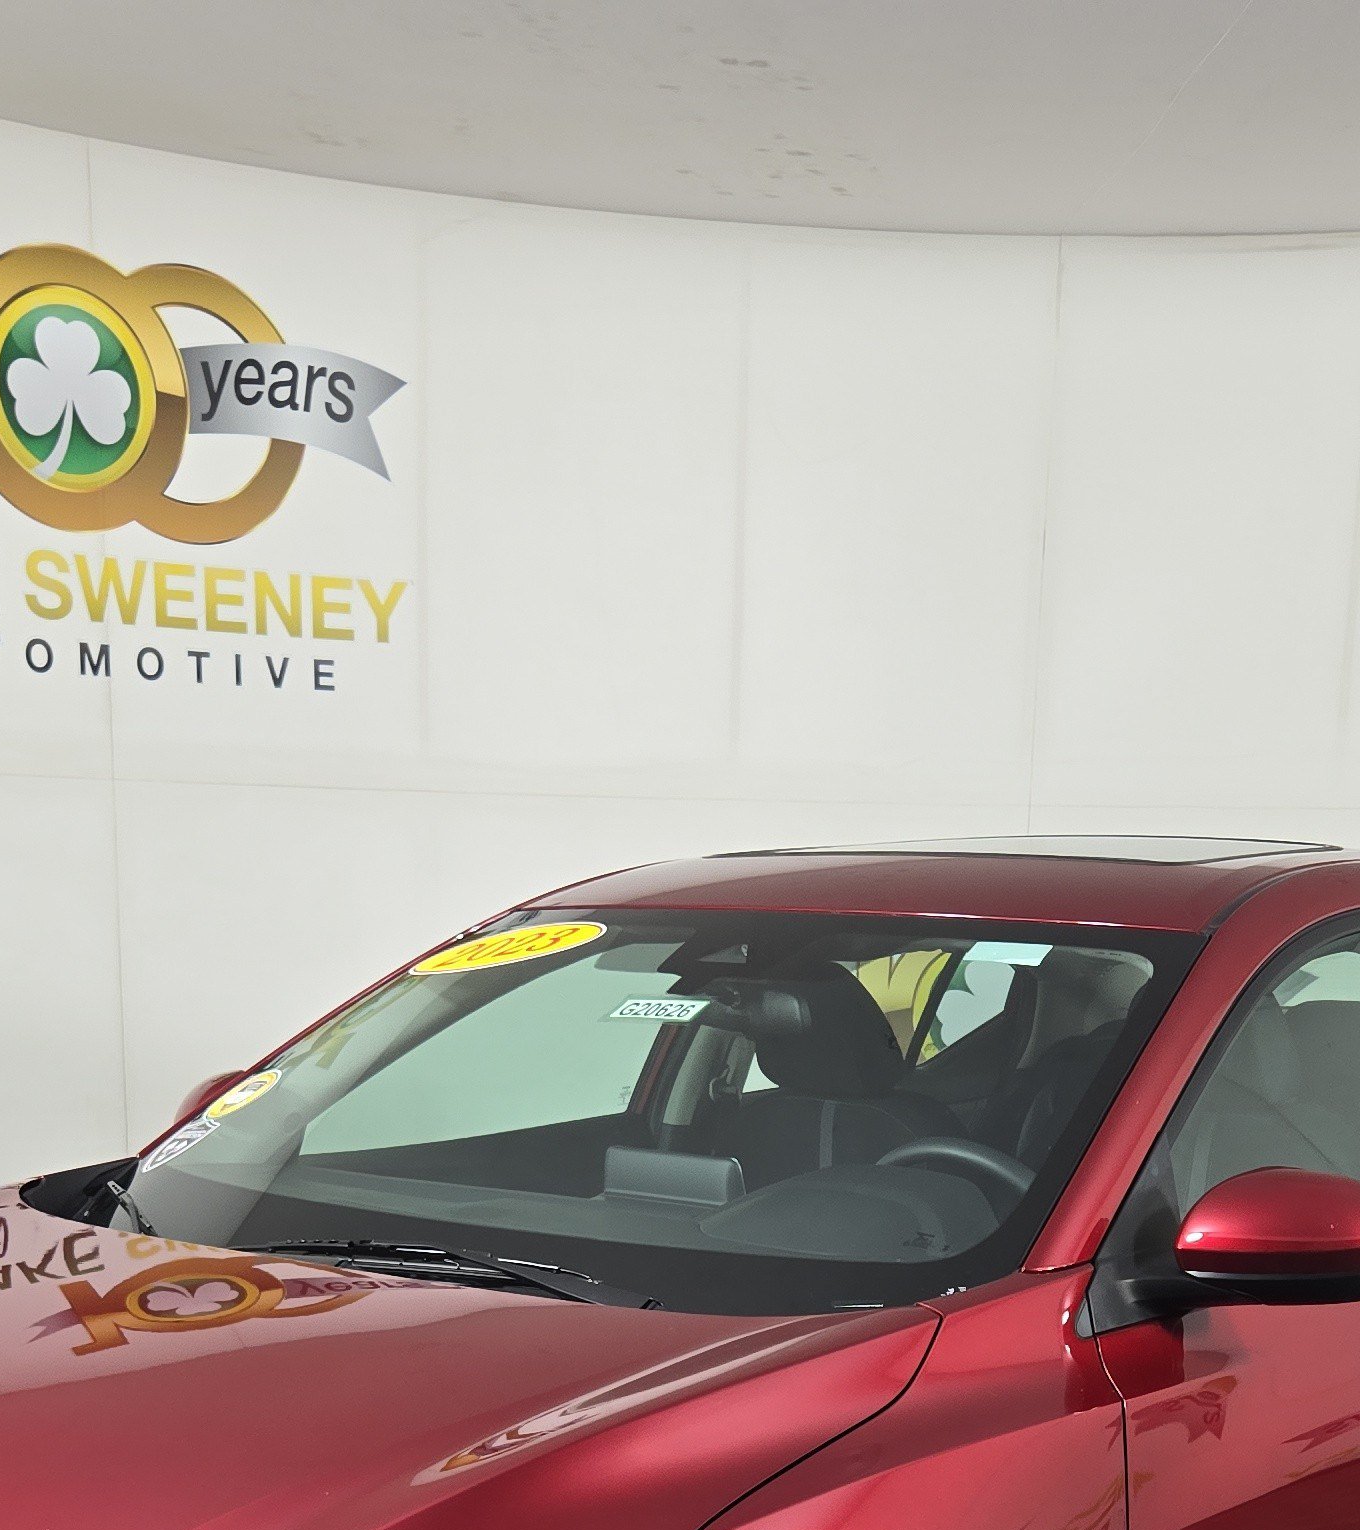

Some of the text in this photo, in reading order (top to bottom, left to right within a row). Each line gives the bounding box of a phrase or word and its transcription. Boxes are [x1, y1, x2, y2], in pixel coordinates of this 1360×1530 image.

[199, 357, 357, 424] years
[23, 548, 409, 644] SWEENEY
[431, 926, 581, 969] 2023
[619, 1002, 696, 1018] G20626
